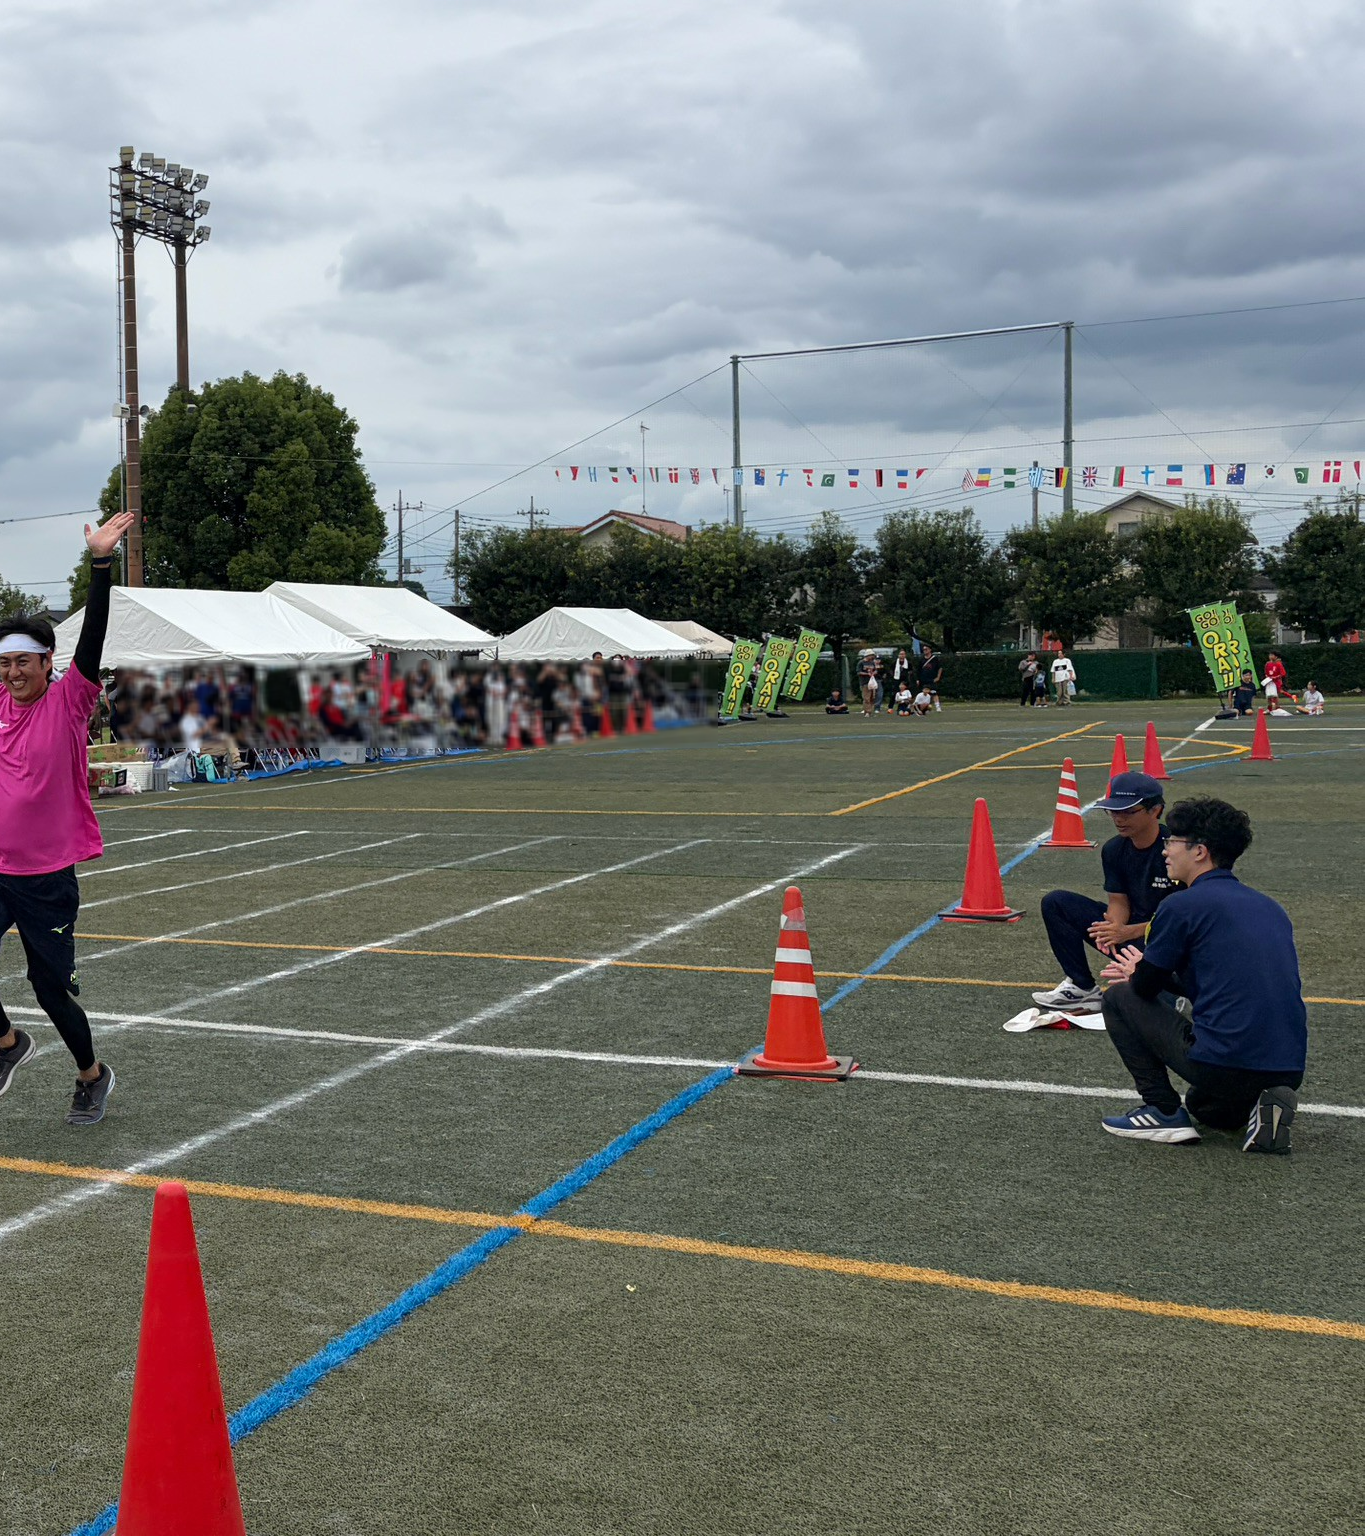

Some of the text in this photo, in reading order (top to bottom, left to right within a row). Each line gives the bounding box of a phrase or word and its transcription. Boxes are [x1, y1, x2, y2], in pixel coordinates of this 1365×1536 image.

[1195, 609, 1216, 623] GO!
[1201, 616, 1220, 629] GO!
[1223, 615, 1235, 625] O!
[787, 650, 811, 697] ORA!!
[1202, 630, 1234, 688] ORA!!
[725, 661, 745, 715] ORA!!
[757, 658, 780, 708] ORA!!
